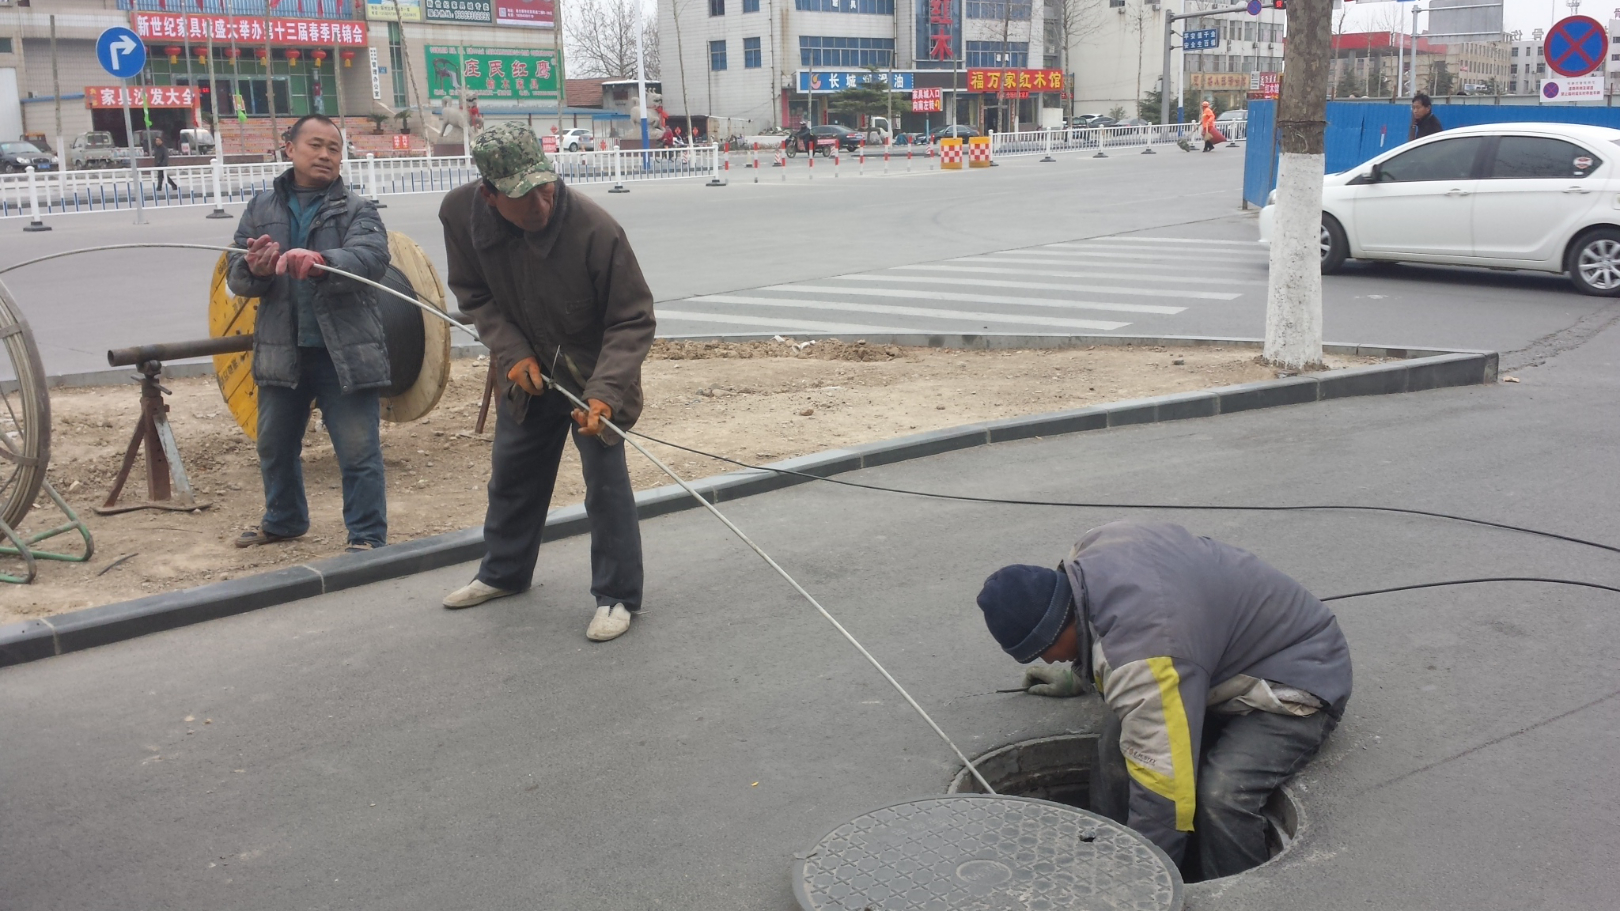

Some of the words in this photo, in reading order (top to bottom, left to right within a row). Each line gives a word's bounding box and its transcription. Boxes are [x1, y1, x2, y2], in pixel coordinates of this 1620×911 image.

[970, 71, 1061, 89] 福万家红木馆
[100, 88, 196, 106] 家具沙发大全
[912, 89, 940, 100] 家具城入口
